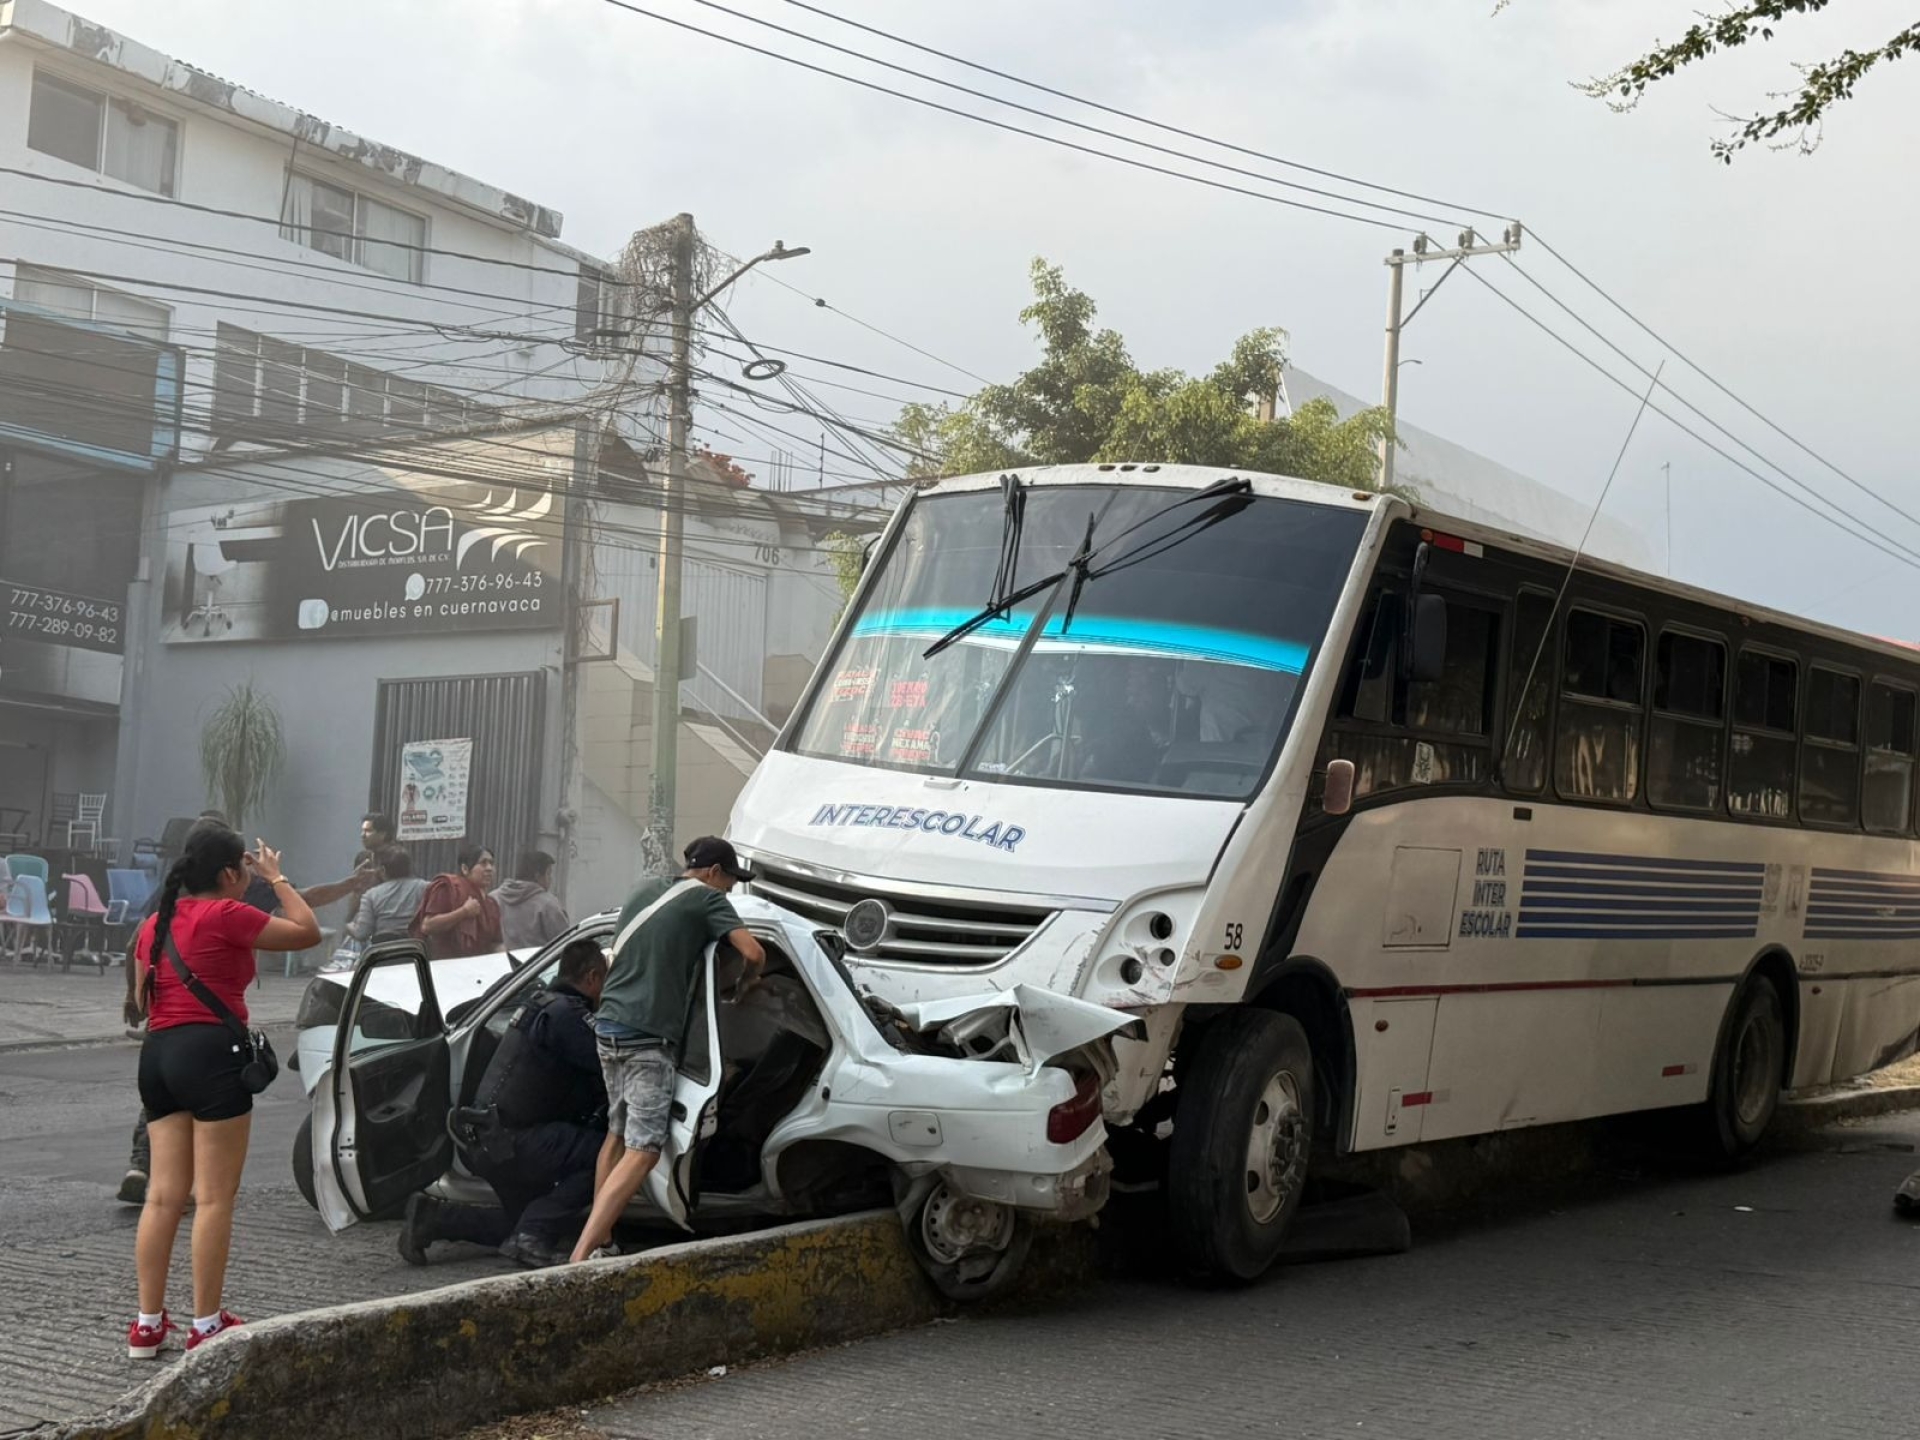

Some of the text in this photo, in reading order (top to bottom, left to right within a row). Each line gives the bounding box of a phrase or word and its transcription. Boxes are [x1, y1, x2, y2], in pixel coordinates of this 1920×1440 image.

[312, 506, 454, 571] VICSA
[755, 542, 780, 565] 706
[425, 571, 543, 595] 777-376-96-43
[11, 589, 119, 622] 777-376-96-43
[330, 598, 541, 622] @muebles en cuernavaca
[9, 611, 117, 644] 777-289-09-82
[808, 803, 1026, 852] INTERESCOLAR
[1476, 848, 1506, 876] RUTA
[1472, 880, 1506, 907] INTER
[1224, 922, 1243, 950] 58
[1458, 911, 1512, 938] ESCOLAR
